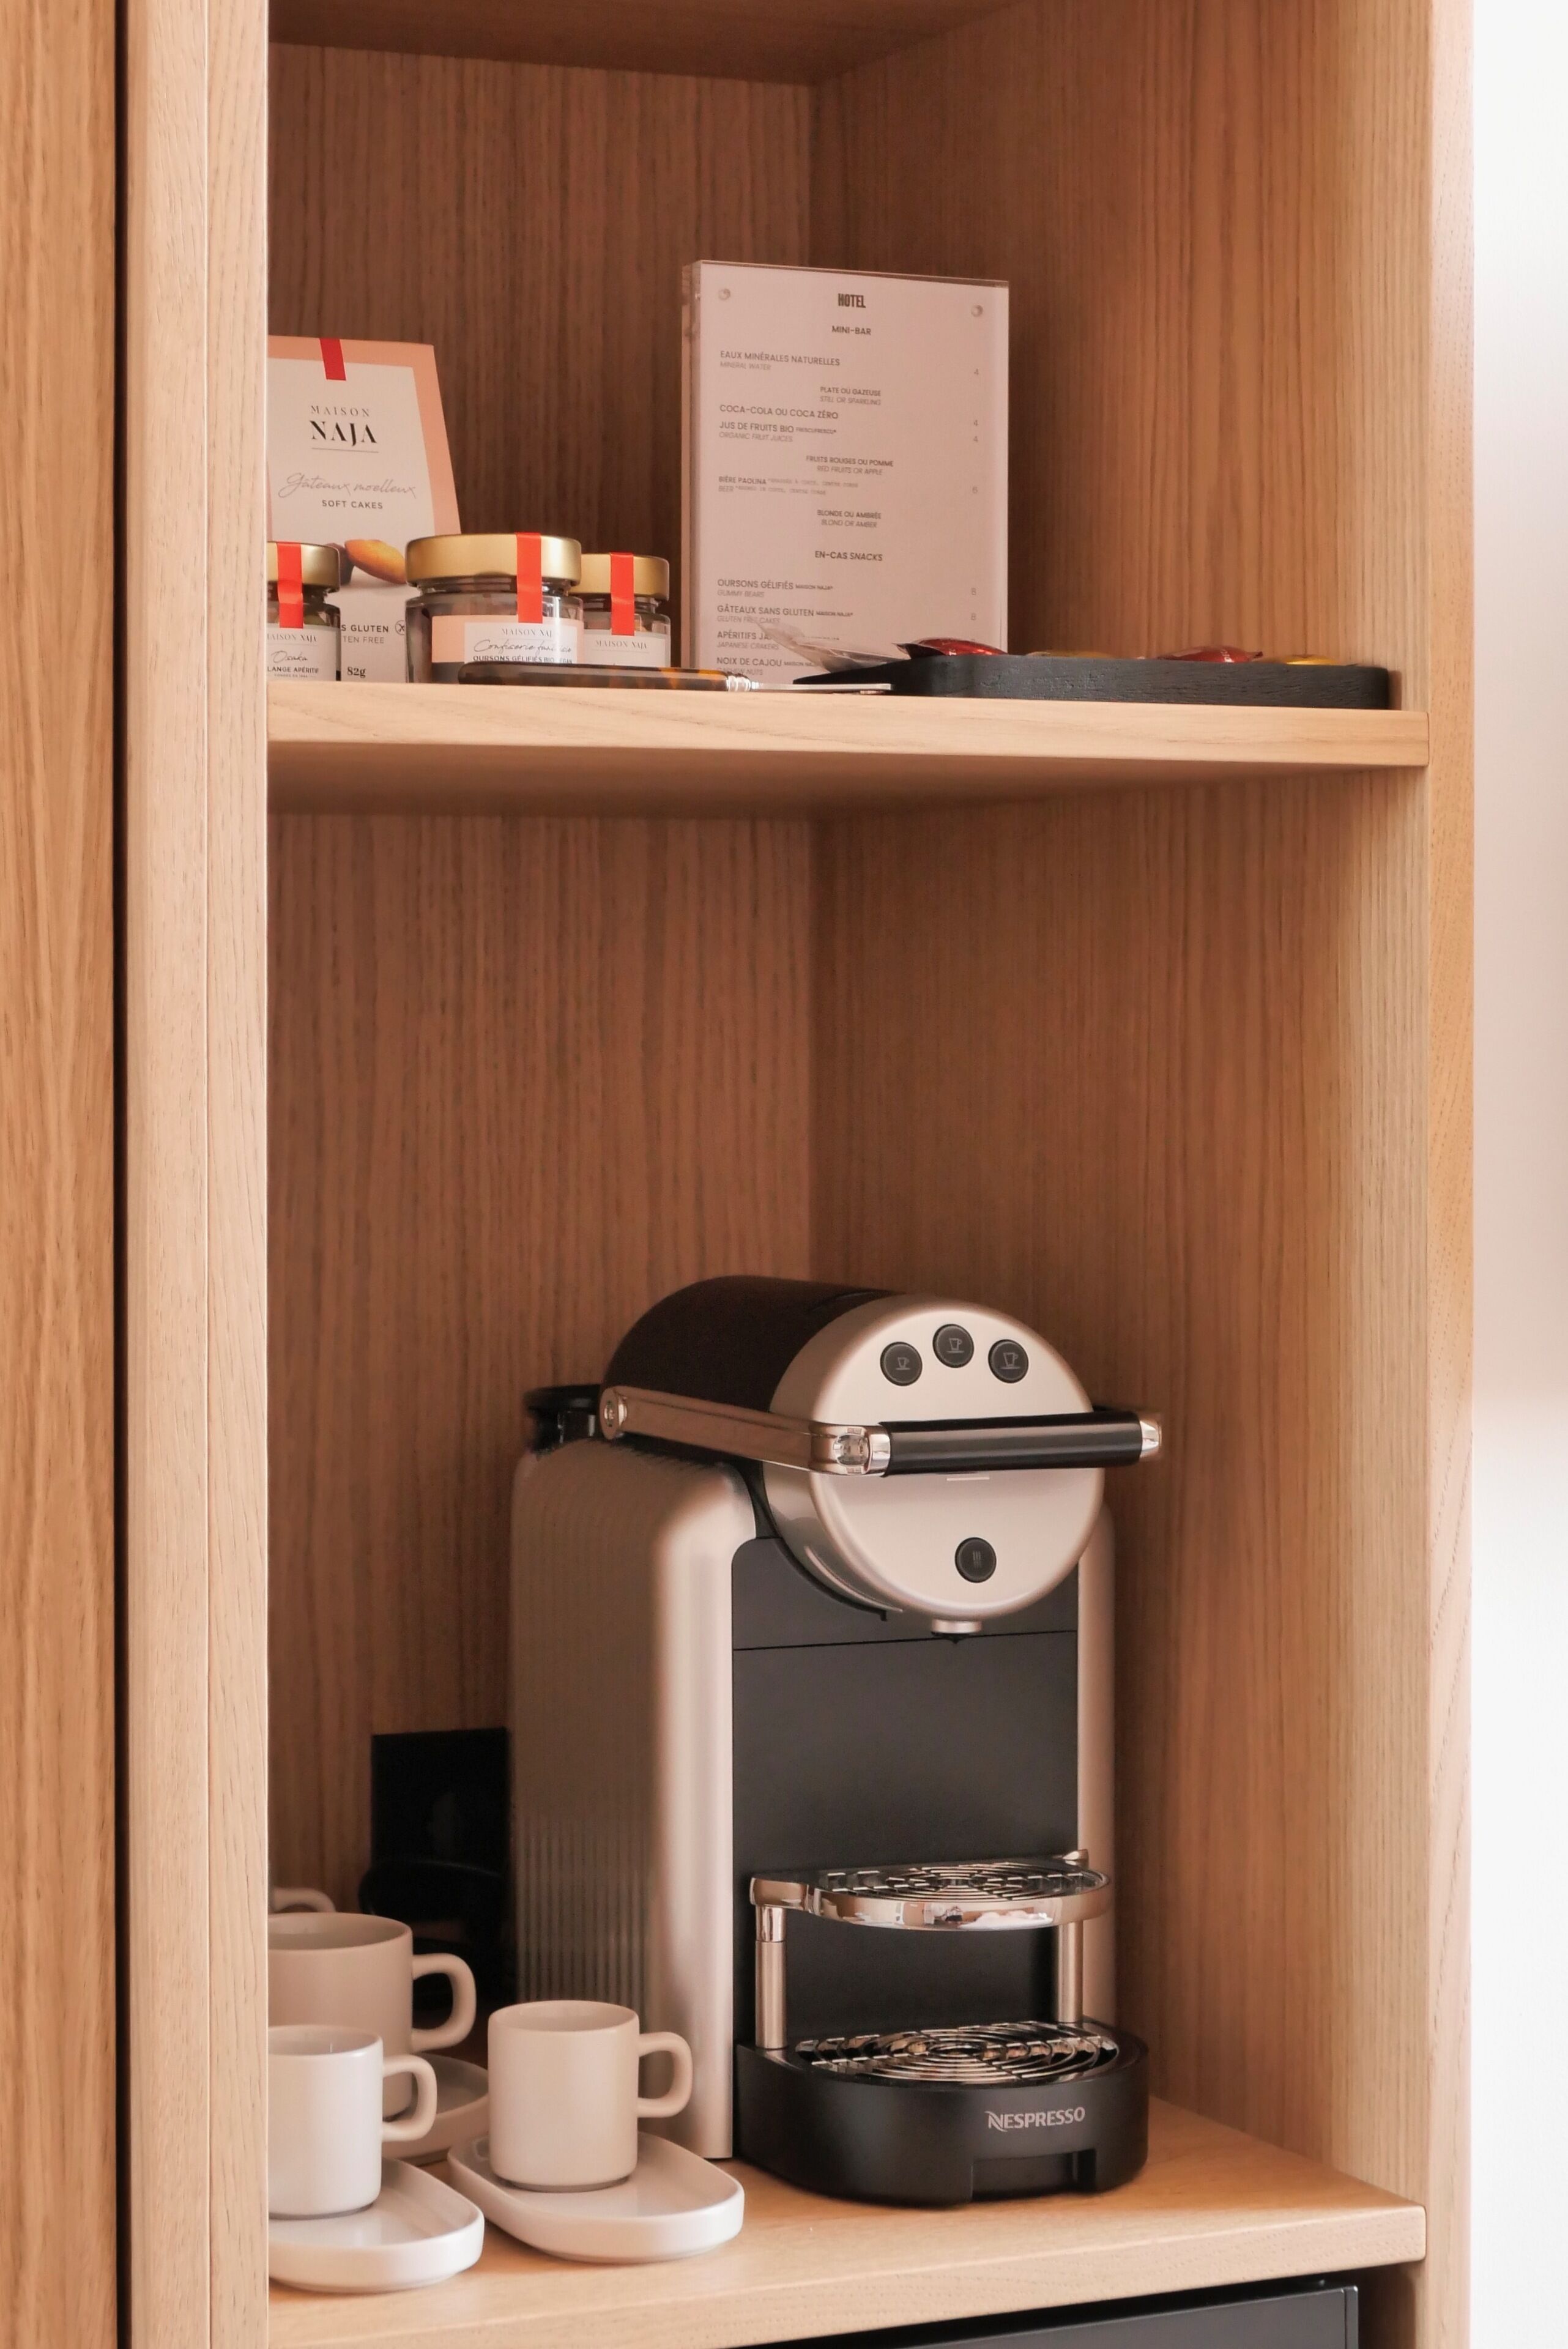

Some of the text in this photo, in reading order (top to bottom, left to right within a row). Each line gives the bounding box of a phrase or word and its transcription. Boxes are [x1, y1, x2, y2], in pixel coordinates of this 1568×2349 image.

[838, 293, 866, 308] HOTEL
[831, 325, 872, 335] MINI-BAR
[720, 350, 841, 366] EAUX MINÉRALES NATURELLES
[311, 405, 370, 417] MAISON
[719, 404, 773, 415] COCA-COLA
[789, 409, 816, 418] COCA
[817, 409, 839, 419] ZÉRO
[750, 423, 778, 432] FRUITS
[310, 420, 377, 447] NAJA
[353, 479, 417, 500] moelleux
[322, 499, 384, 510] SOFT CAKES
[814, 551, 883, 562] EN-CAS SNACKS
[717, 579, 759, 588] OURSONS
[760, 580, 793, 590] GÉLIFIÉS
[717, 603, 757, 614] GÂTEAUX
[759, 606, 781, 615] SANS
[782, 607, 814, 617] GLUTEN
[350, 624, 389, 633] GLUTEN
[502, 628, 536, 636] MAISON
[300, 634, 317, 643] NAJA
[717, 629, 757, 640] APÉRITIFS
[362, 636, 385, 645] FREE
[595, 639, 647, 650] MAISON NAJA
[716, 656, 738, 666] NOIX
[752, 658, 782, 667] CAJOU
[347, 666, 366, 678] 82g
[983, 2106, 1086, 2132] NESPRESSO
